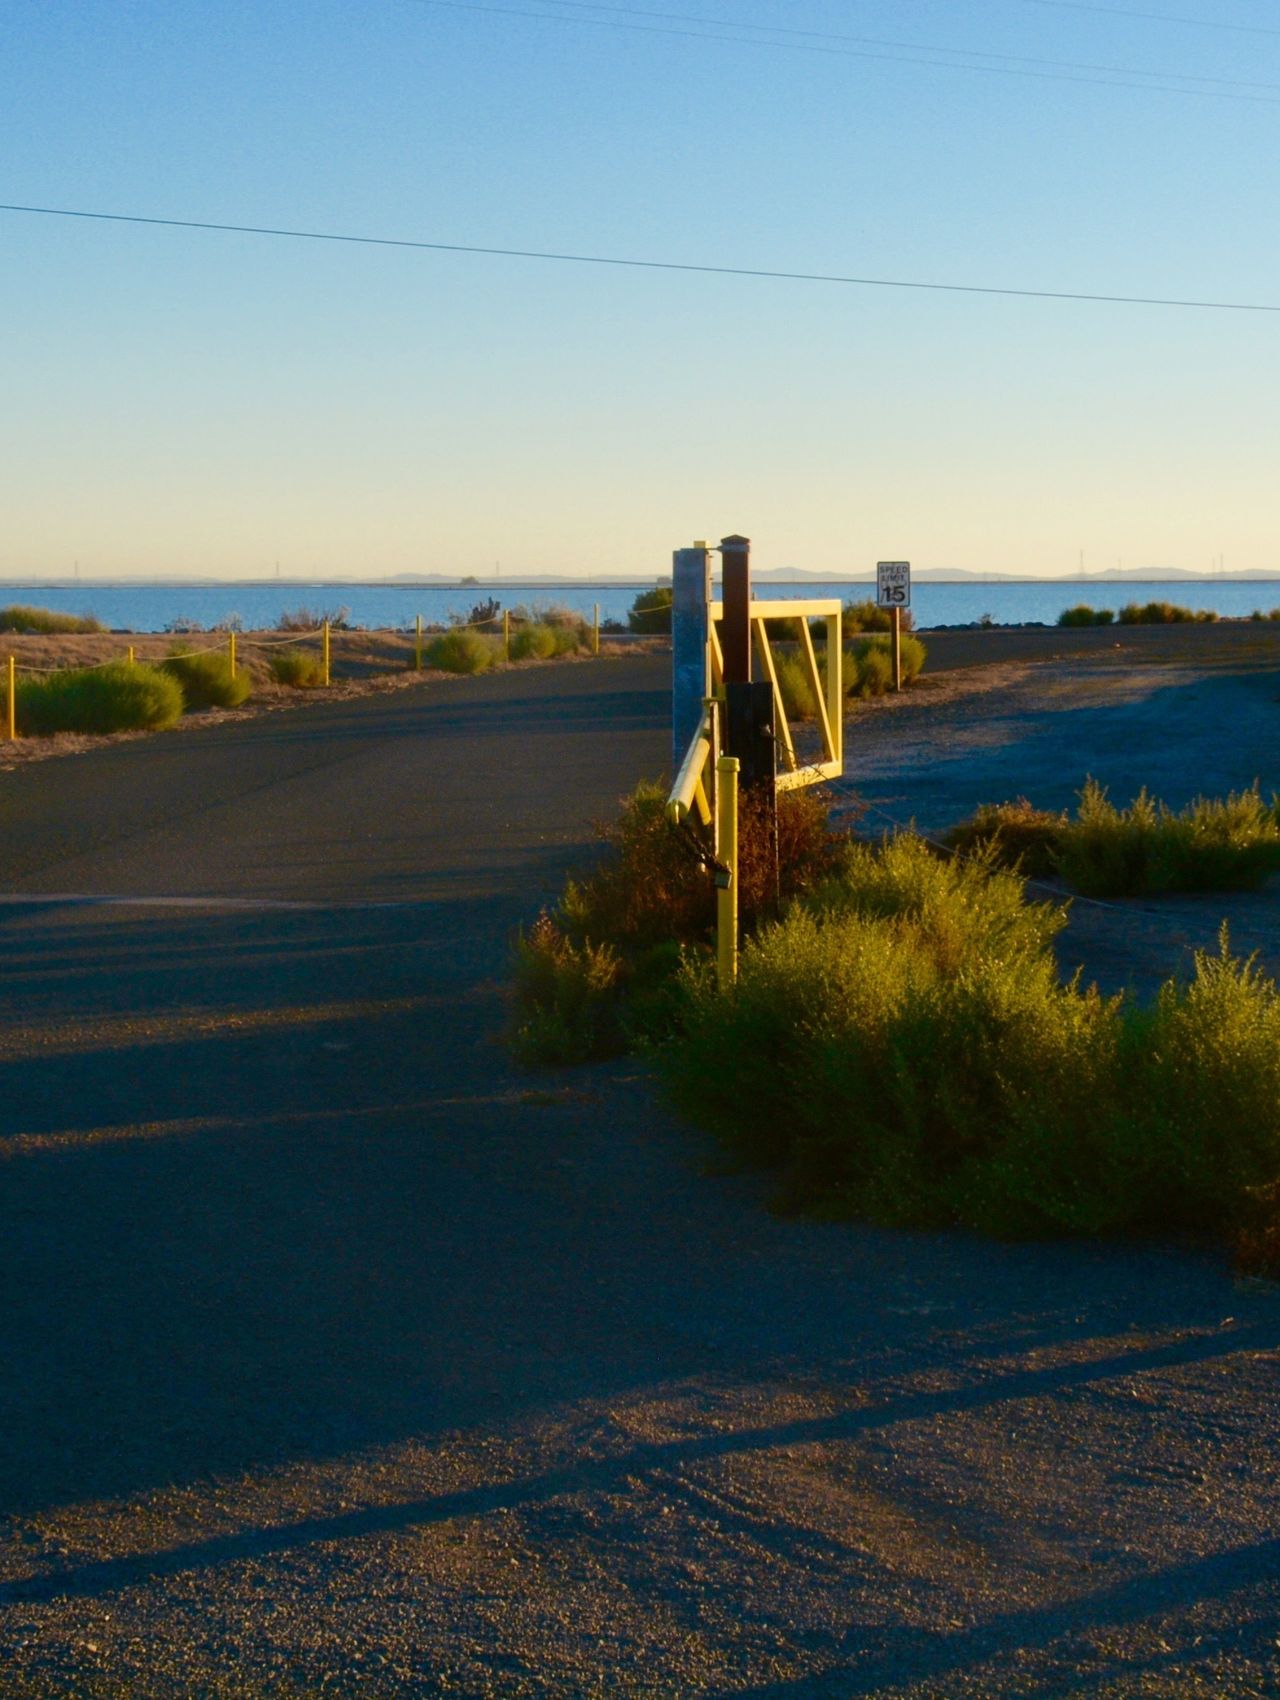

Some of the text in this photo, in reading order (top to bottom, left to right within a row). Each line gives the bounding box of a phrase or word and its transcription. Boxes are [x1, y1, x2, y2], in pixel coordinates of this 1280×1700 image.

[880, 565, 908, 574] SPEED
[881, 574, 905, 582] LIMIT
[882, 585, 906, 603] 15
